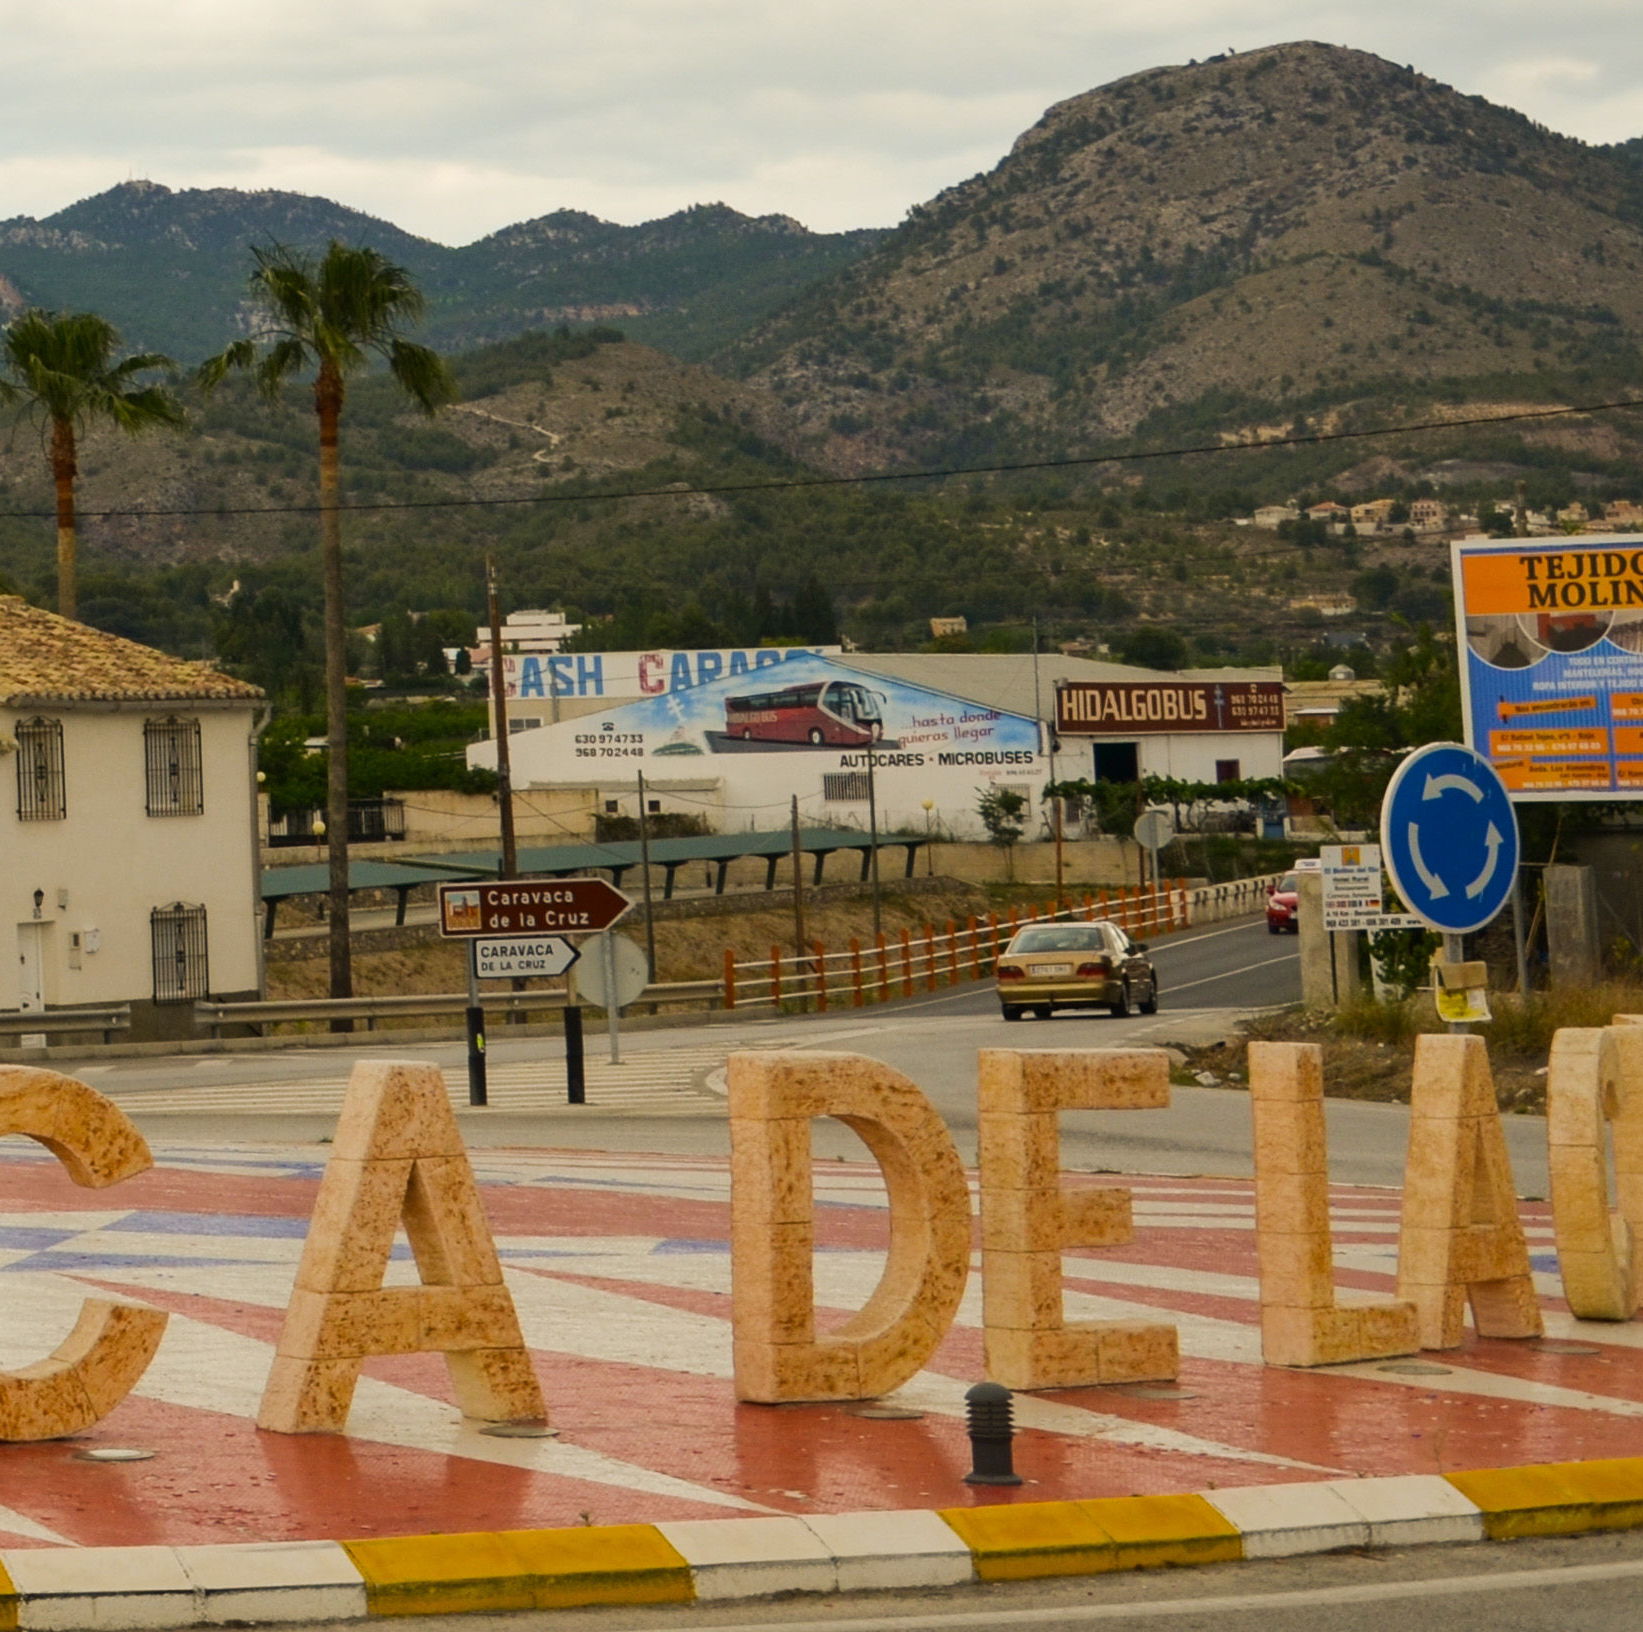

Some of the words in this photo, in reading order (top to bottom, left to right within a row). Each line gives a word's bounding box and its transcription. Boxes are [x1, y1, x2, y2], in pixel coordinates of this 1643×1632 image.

[638, 649, 823, 695] CARA
[1061, 689, 1207, 721] HIDALGOBUS
[959, 710, 1002, 724] donde
[575, 734, 595, 744] 630
[598, 734, 644, 744] 974733
[898, 730, 949, 748] quieras
[953, 726, 995, 743] llegar
[575, 747, 596, 757] 968
[597, 747, 644, 757] 702448
[840, 753, 924, 768] AUTOCARES
[938, 750, 1034, 766] MICROBUSES
[487, 890, 574, 906] Caravaca
[489, 914, 510, 928] de
[519, 912, 536, 927] la
[545, 911, 590, 926] Cruz
[481, 944, 554, 958] CARAVACA
[481, 962, 495, 971] DE
[500, 961, 513, 970] LA
[518, 960, 547, 969] CRUZ
